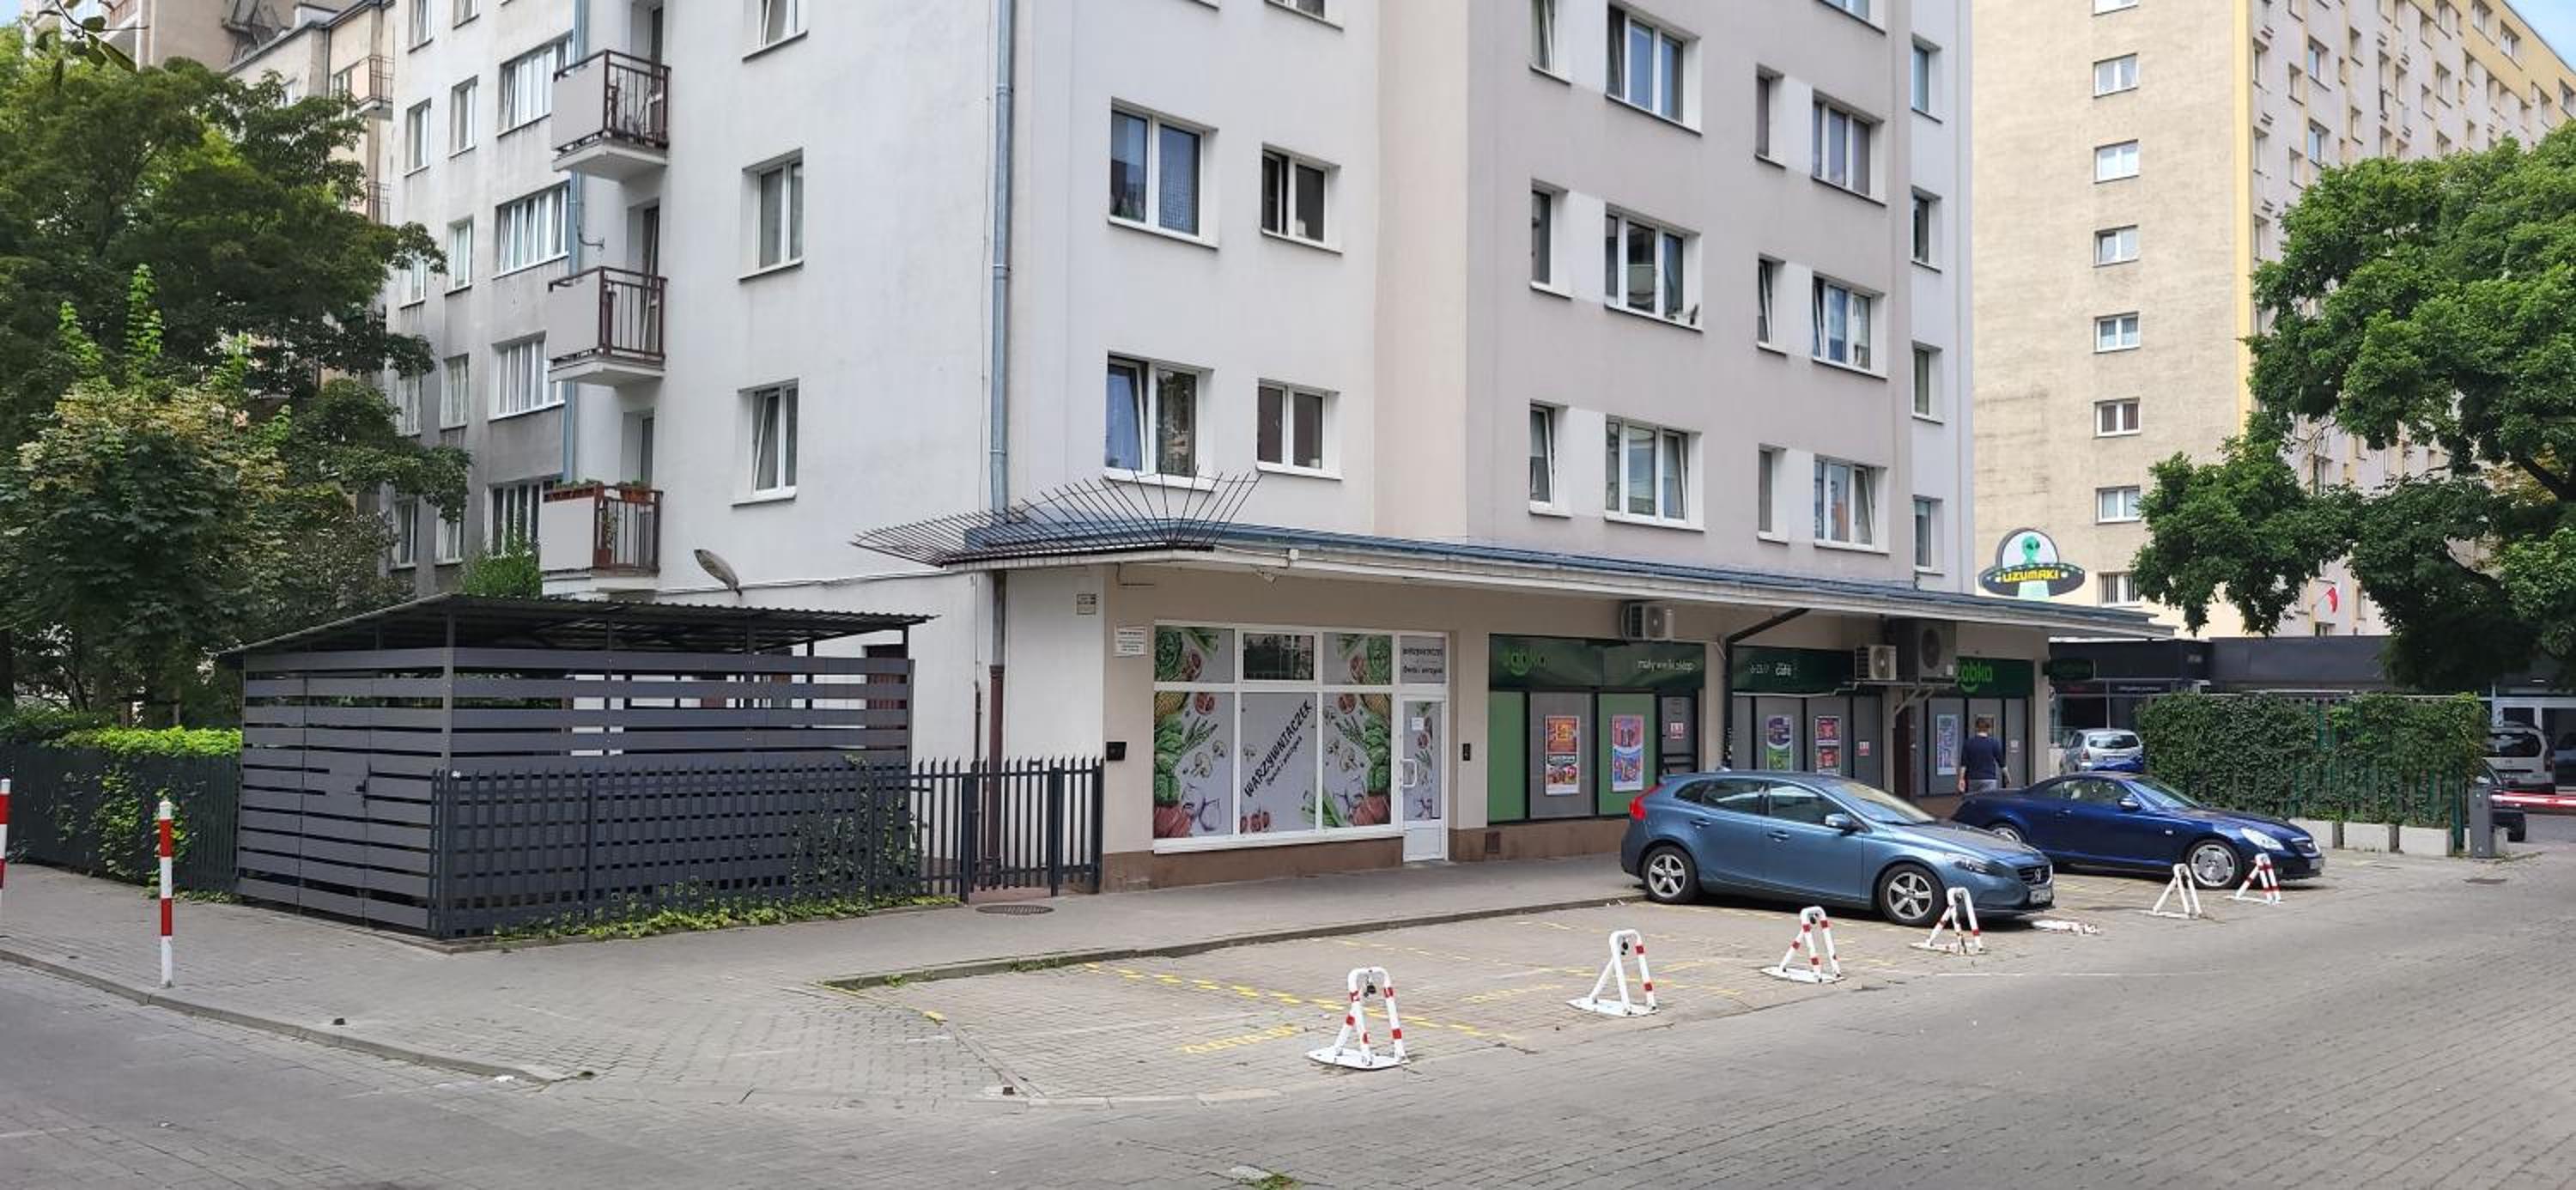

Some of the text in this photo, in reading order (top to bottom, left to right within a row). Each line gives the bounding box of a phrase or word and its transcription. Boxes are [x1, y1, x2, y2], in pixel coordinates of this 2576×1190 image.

[2002, 569, 2059, 583] UZUMAKI
[1503, 647, 1546, 670] abka
[1244, 699, 1312, 798] WARZYWNIACZEK
